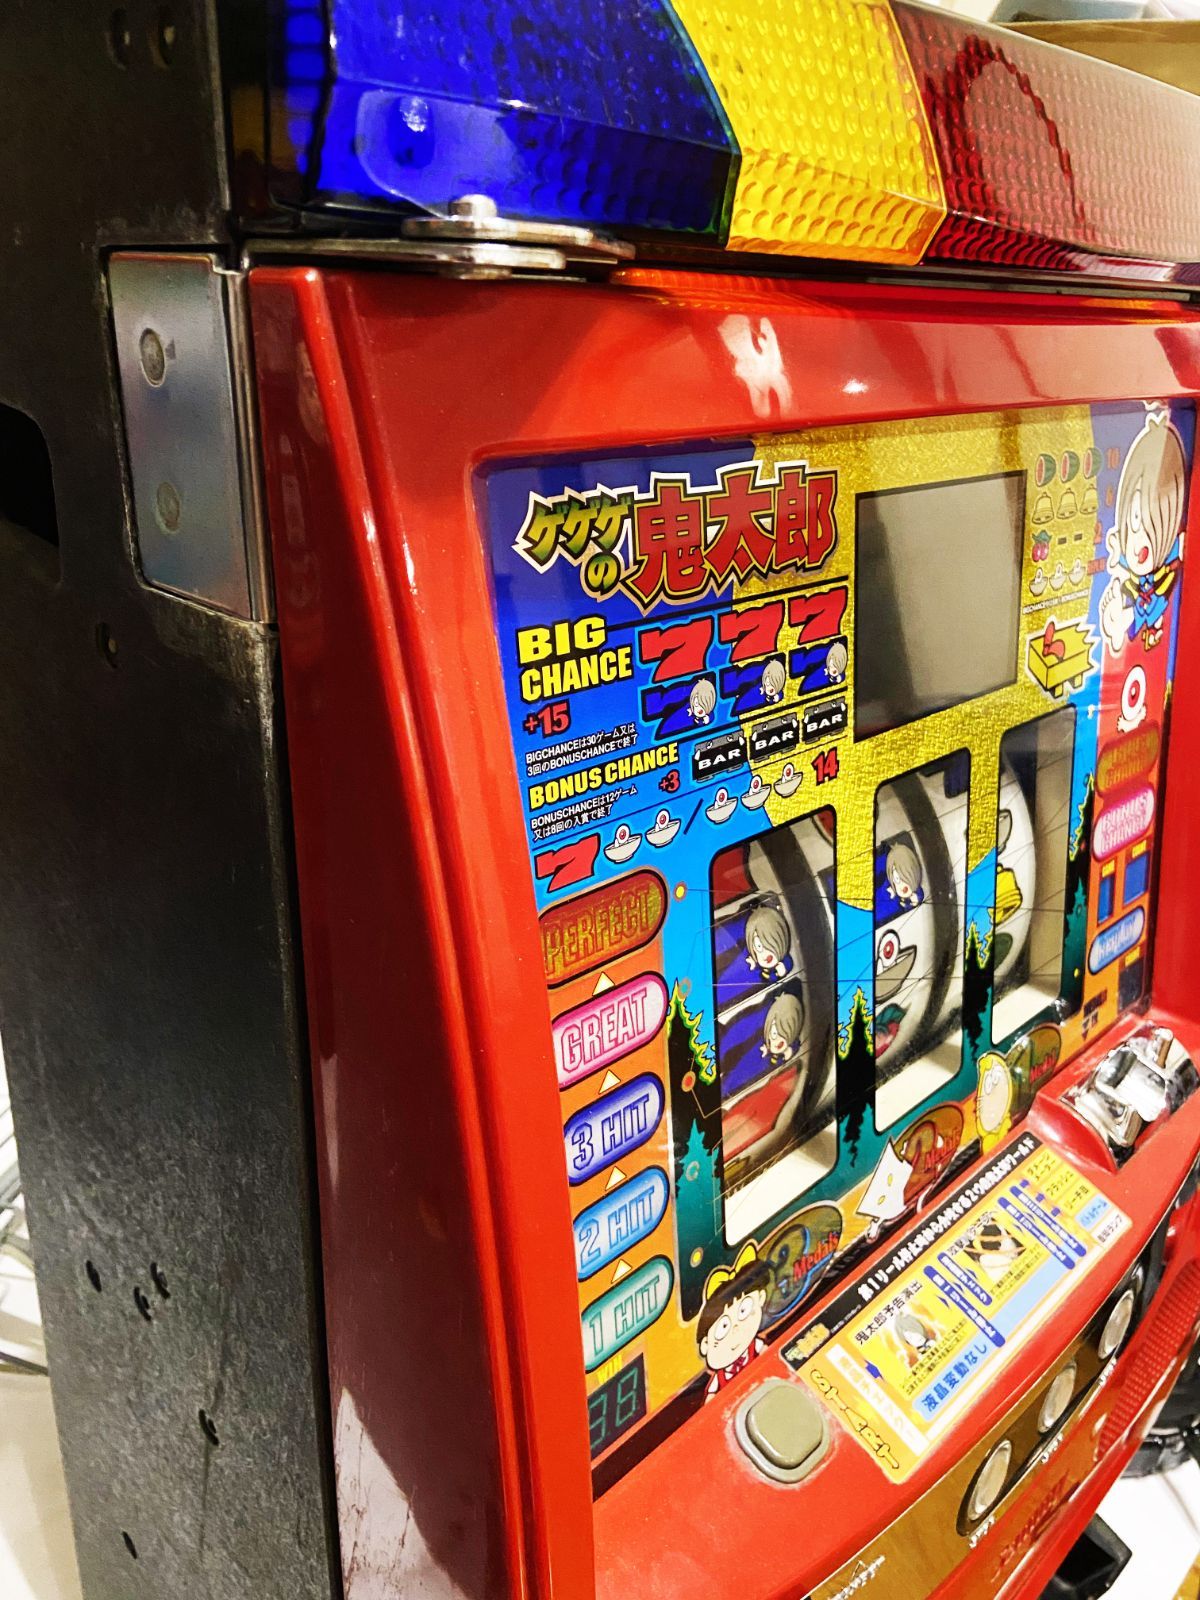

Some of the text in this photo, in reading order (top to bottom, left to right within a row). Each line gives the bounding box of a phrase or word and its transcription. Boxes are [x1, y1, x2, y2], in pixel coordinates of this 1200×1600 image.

[517, 616, 607, 663] BIG
[521, 647, 632, 701] CHANCE
[524, 701, 570, 737] +15
[698, 713, 843, 770] BAR BAR BAR
[529, 742, 680, 810] BONUS CHANCE
[659, 769, 681, 793] +3
[812, 747, 840, 786] 14
[543, 887, 652, 977] PERFECT
[561, 990, 647, 1074] GREAT
[571, 1094, 650, 1171] 3 HIT
[577, 1186, 656, 1270] 2 HIT
[587, 1275, 660, 1356] 1 HIT
[921, 1343, 988, 1413] 液晶変動なし
[809, 1368, 901, 1471] START
